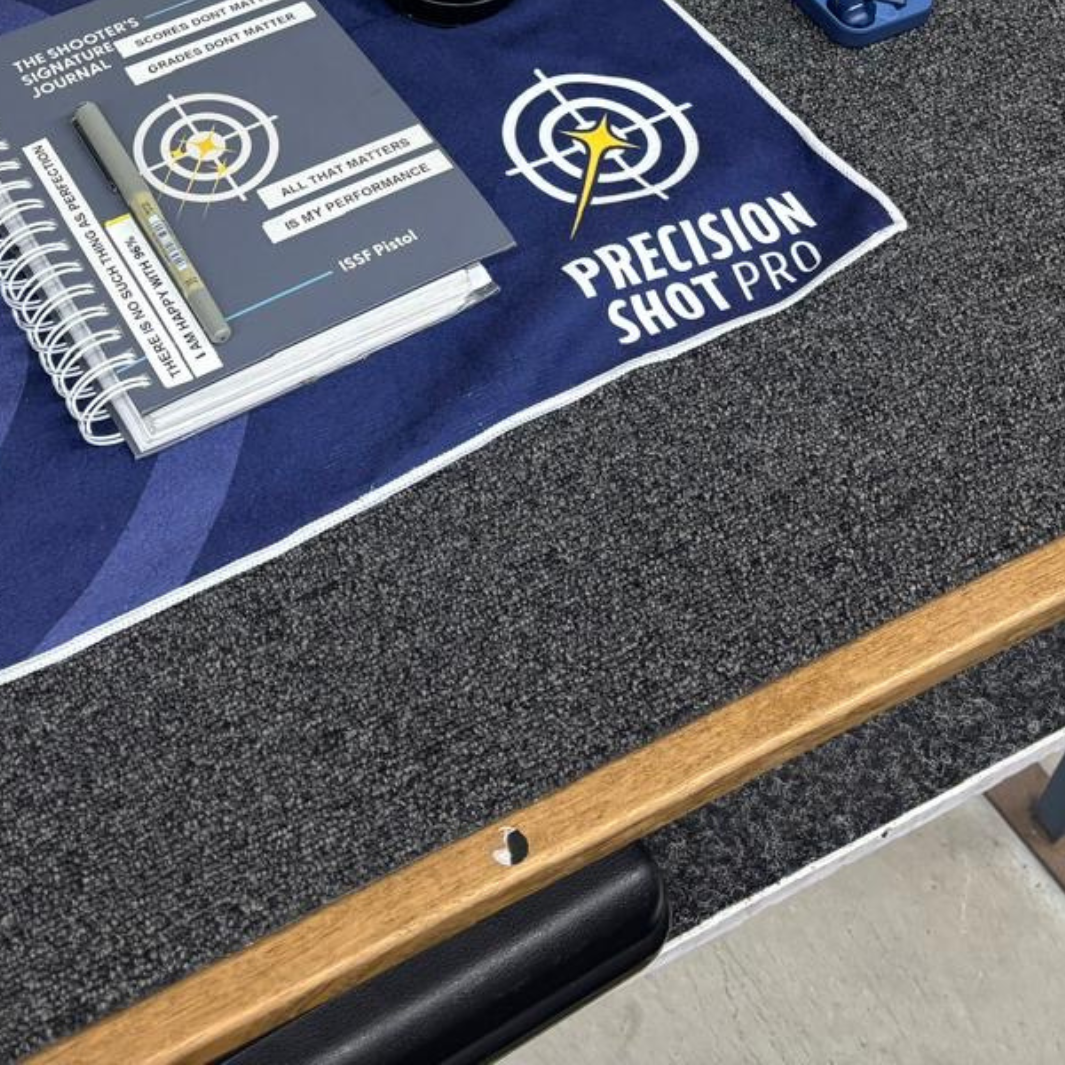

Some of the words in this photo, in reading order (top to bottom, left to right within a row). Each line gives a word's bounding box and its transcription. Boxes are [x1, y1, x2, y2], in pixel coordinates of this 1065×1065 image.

[12, 53, 47, 74] THE
[46, 16, 141, 60] SHOOTER'S
[134, 22, 190, 48] SCORES
[190, 8, 228, 31] DONT
[147, 47, 204, 74] GRADES
[204, 32, 242, 54] DONT
[243, 11, 297, 37] MATTER
[20, 41, 115, 86] SIGNATURE
[32, 60, 112, 99] JOURNAL
[33, 143, 82, 211] PERFECTION
[281, 181, 309, 198] ALL
[308, 163, 344, 186] THAT
[345, 137, 411, 169] MATTERS
[284, 218, 301, 231] IS
[300, 206, 323, 224] MY
[324, 161, 432, 213] PERFORMANCE
[73, 212, 89, 229] AS
[84, 229, 111, 265] THING
[126, 235, 145, 256] 96%
[337, 248, 373, 273] ISSF
[372, 228, 419, 258] Pistol
[561, 191, 818, 299] PRECISION
[110, 264, 134, 299] SUCH
[137, 256, 168, 290] WITH
[607, 270, 731, 345] SHOT
[731, 239, 823, 301] PRO
[126, 300, 143, 320] NO
[138, 319, 153, 334] IS
[156, 288, 190, 329] HAPPY
[146, 335, 182, 379] THERE
[182, 328, 203, 351] AM
[194, 350, 207, 360] I
